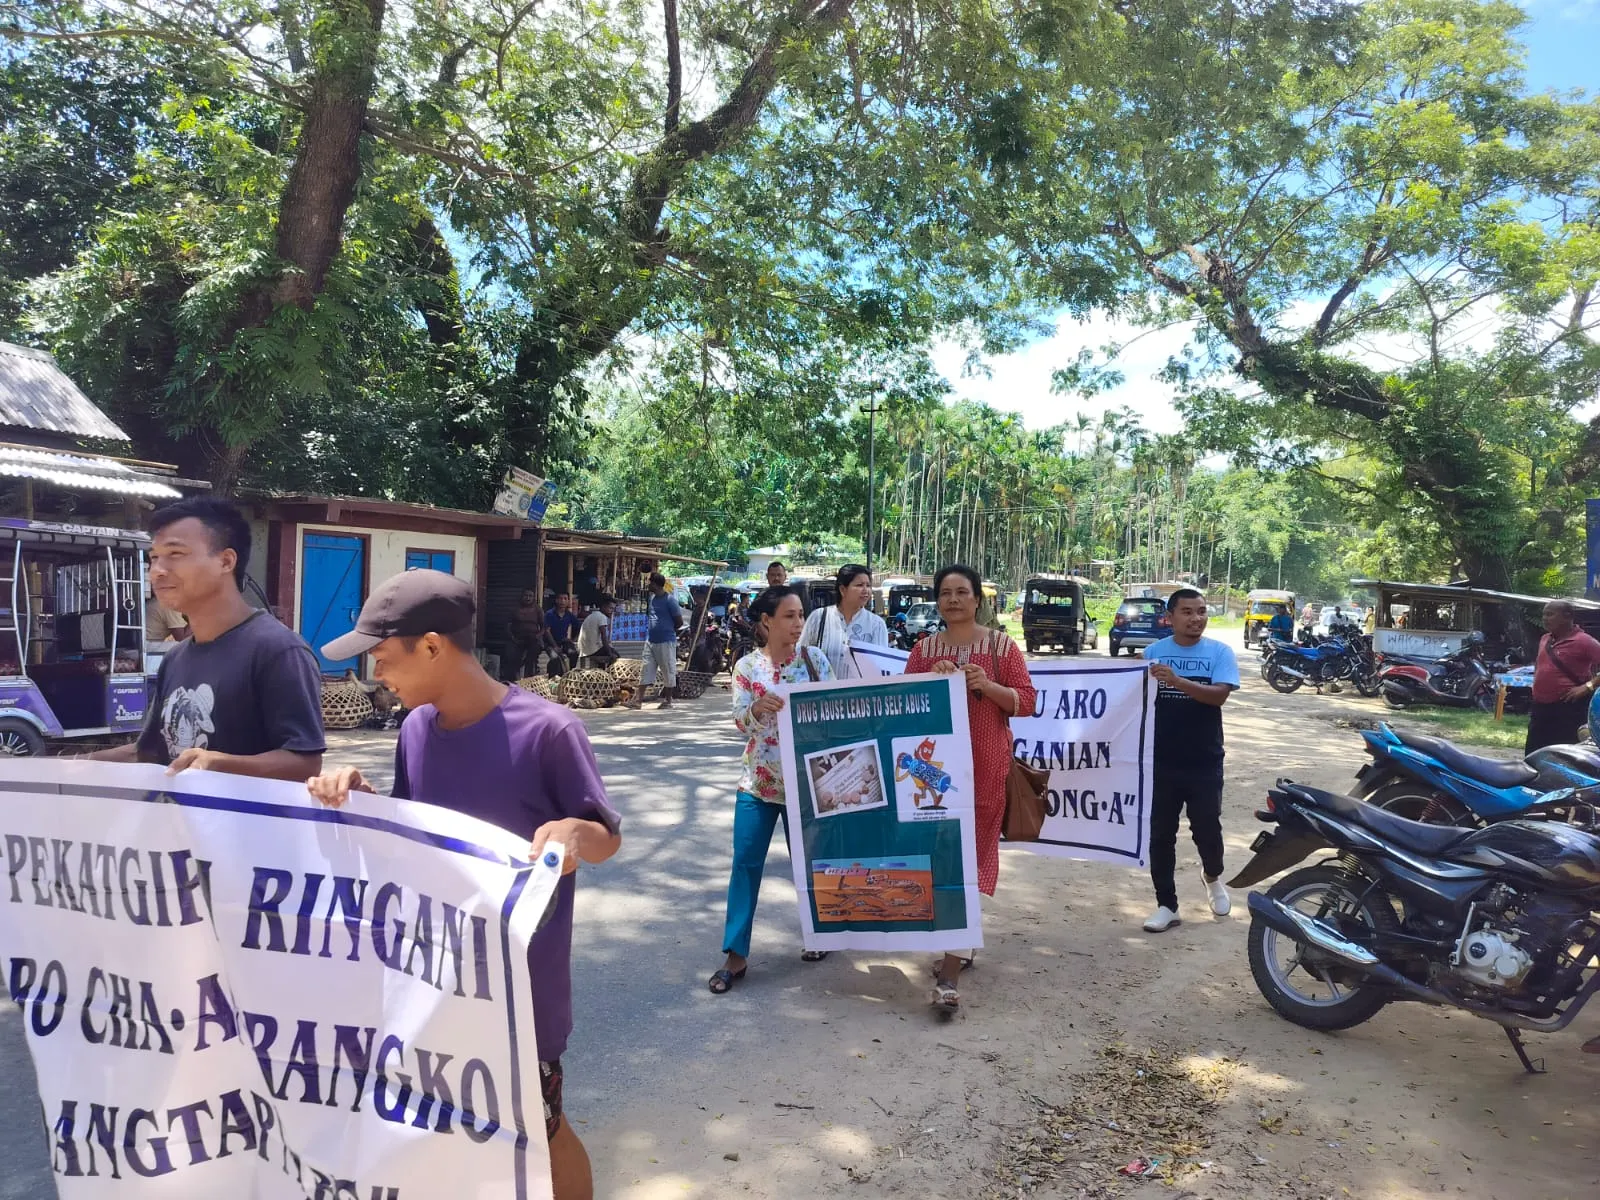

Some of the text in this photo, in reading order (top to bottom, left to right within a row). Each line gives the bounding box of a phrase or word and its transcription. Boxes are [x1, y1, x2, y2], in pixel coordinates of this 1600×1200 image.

[62, 523, 120, 537] CAPTAIN
[796, 693, 931, 724] DRUG ABUSE LEADS TO SELF ABUSE
[1054, 688, 1107, 720] ARO
[241, 866, 494, 1002] RINGANI
